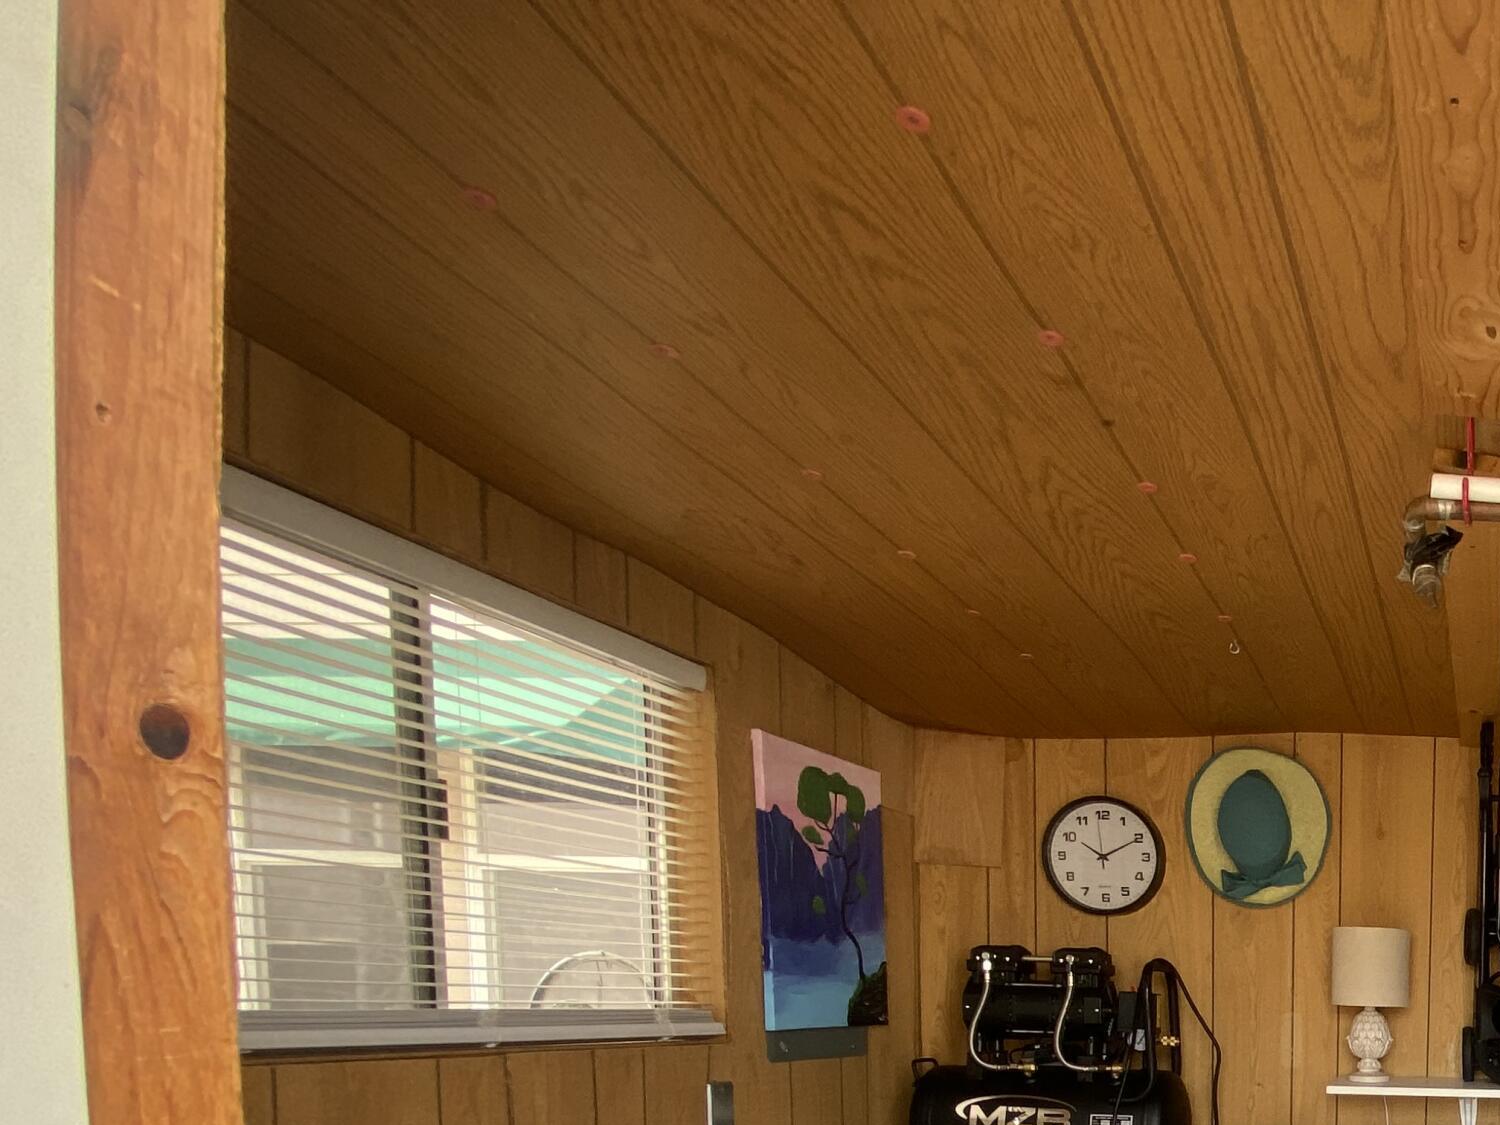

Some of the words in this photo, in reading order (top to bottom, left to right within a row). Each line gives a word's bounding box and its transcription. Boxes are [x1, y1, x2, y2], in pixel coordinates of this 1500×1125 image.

[1095, 810, 1110, 820] 12
[1076, 816, 1088, 826] 11
[1120, 817, 1126, 826] 1
[1063, 831, 1077, 842] 10
[1134, 833, 1144, 844] 2
[1057, 851, 1067, 861] 9
[1141, 852, 1151, 862] 3
[1066, 871, 1075, 881] 8
[1134, 871, 1145, 881] 4
[1080, 886, 1090, 896] 7
[1120, 886, 1130, 897] 5
[1101, 893, 1111, 903] 6
